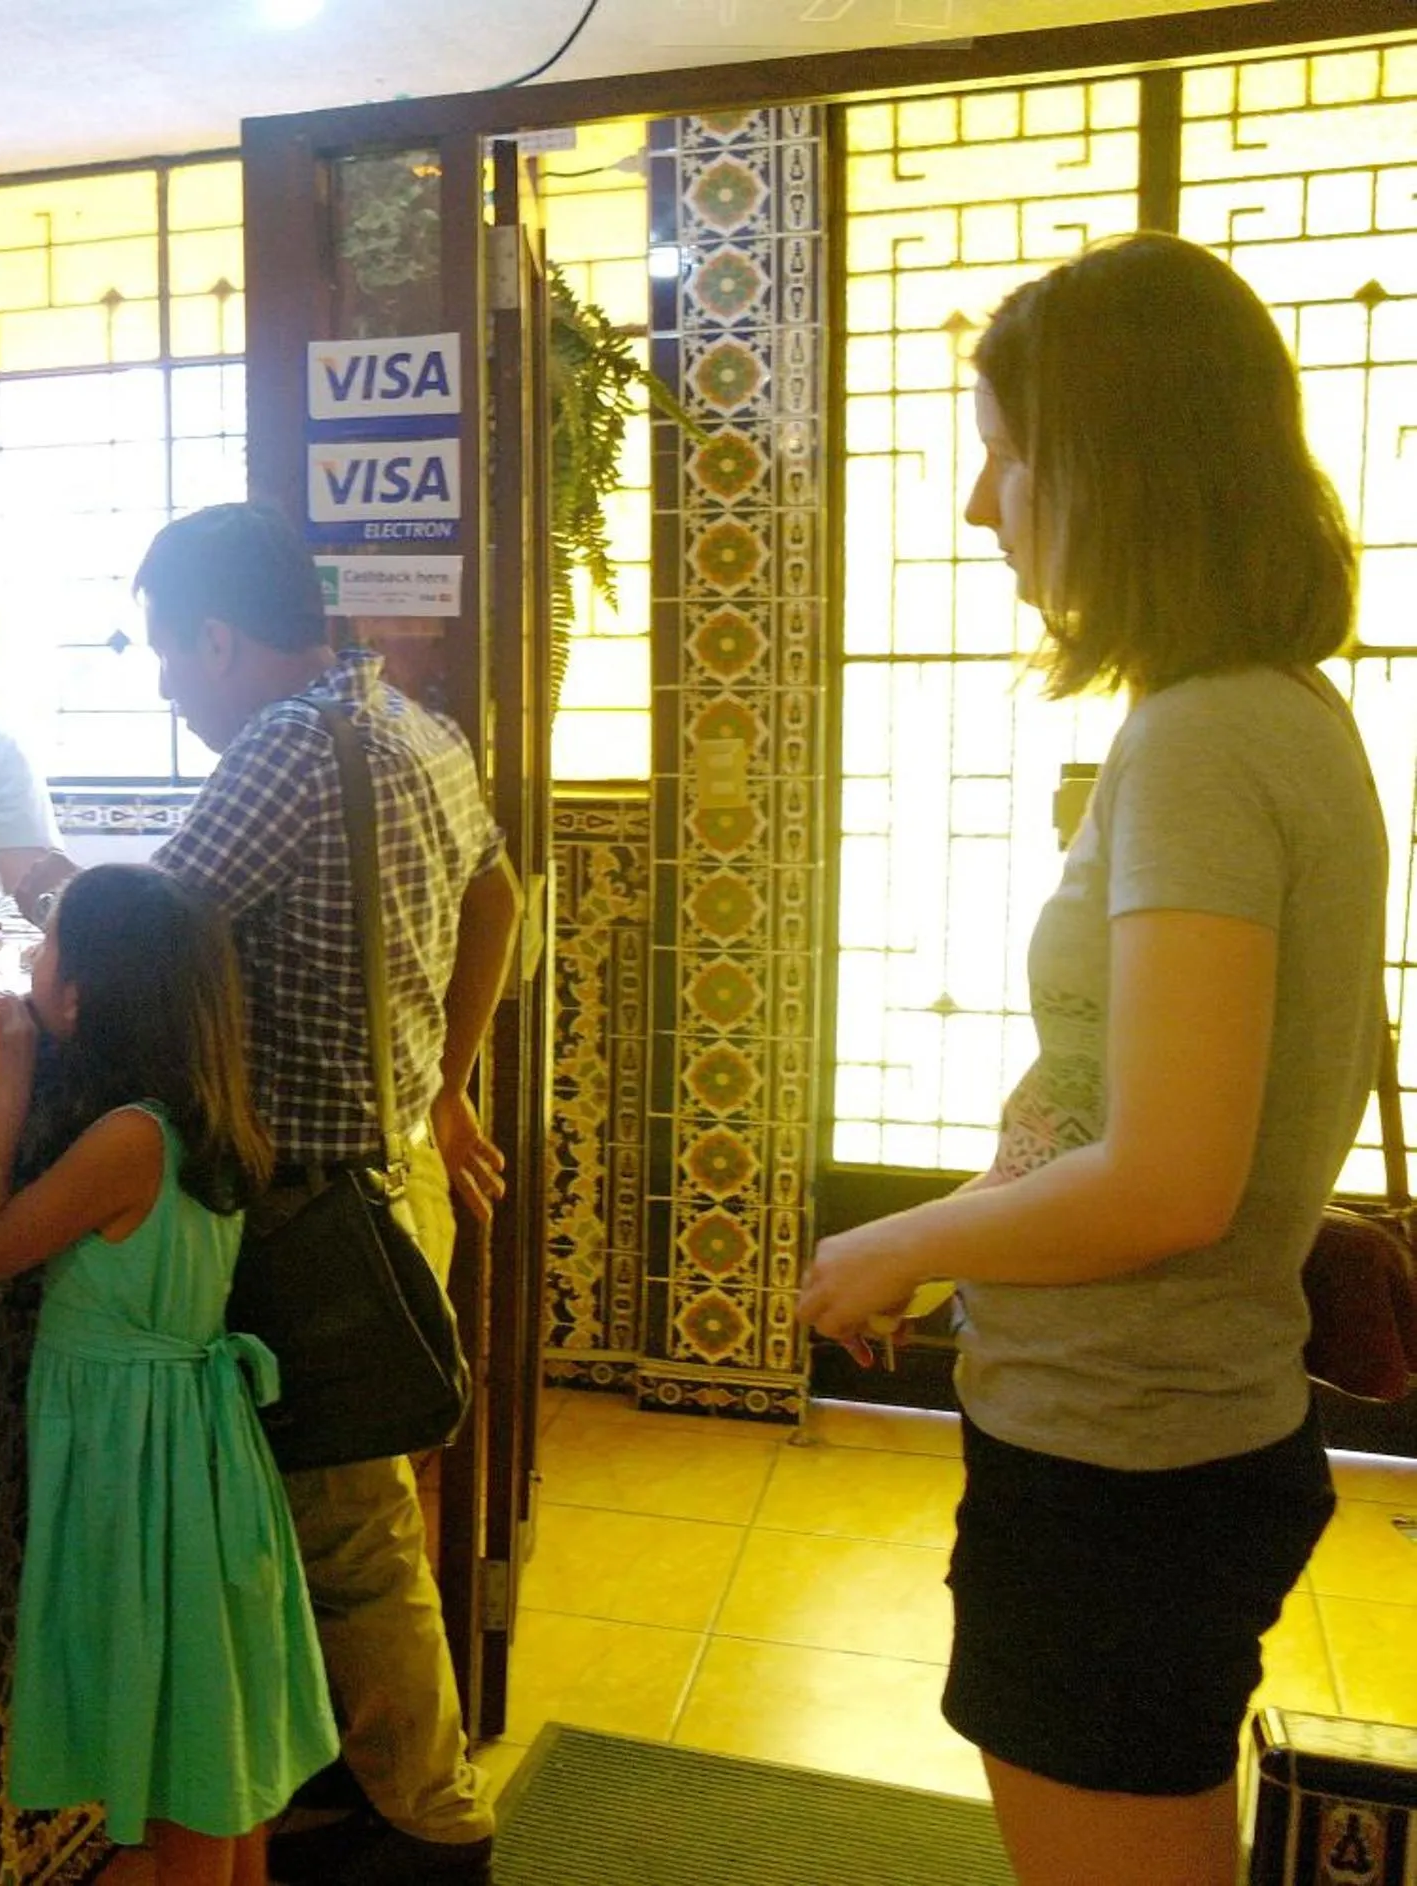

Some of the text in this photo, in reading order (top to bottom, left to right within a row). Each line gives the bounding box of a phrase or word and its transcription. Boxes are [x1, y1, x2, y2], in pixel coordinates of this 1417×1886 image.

[317, 351, 451, 401] VISA
[317, 456, 451, 505] VISA
[364, 521, 453, 540] ELECTRON
